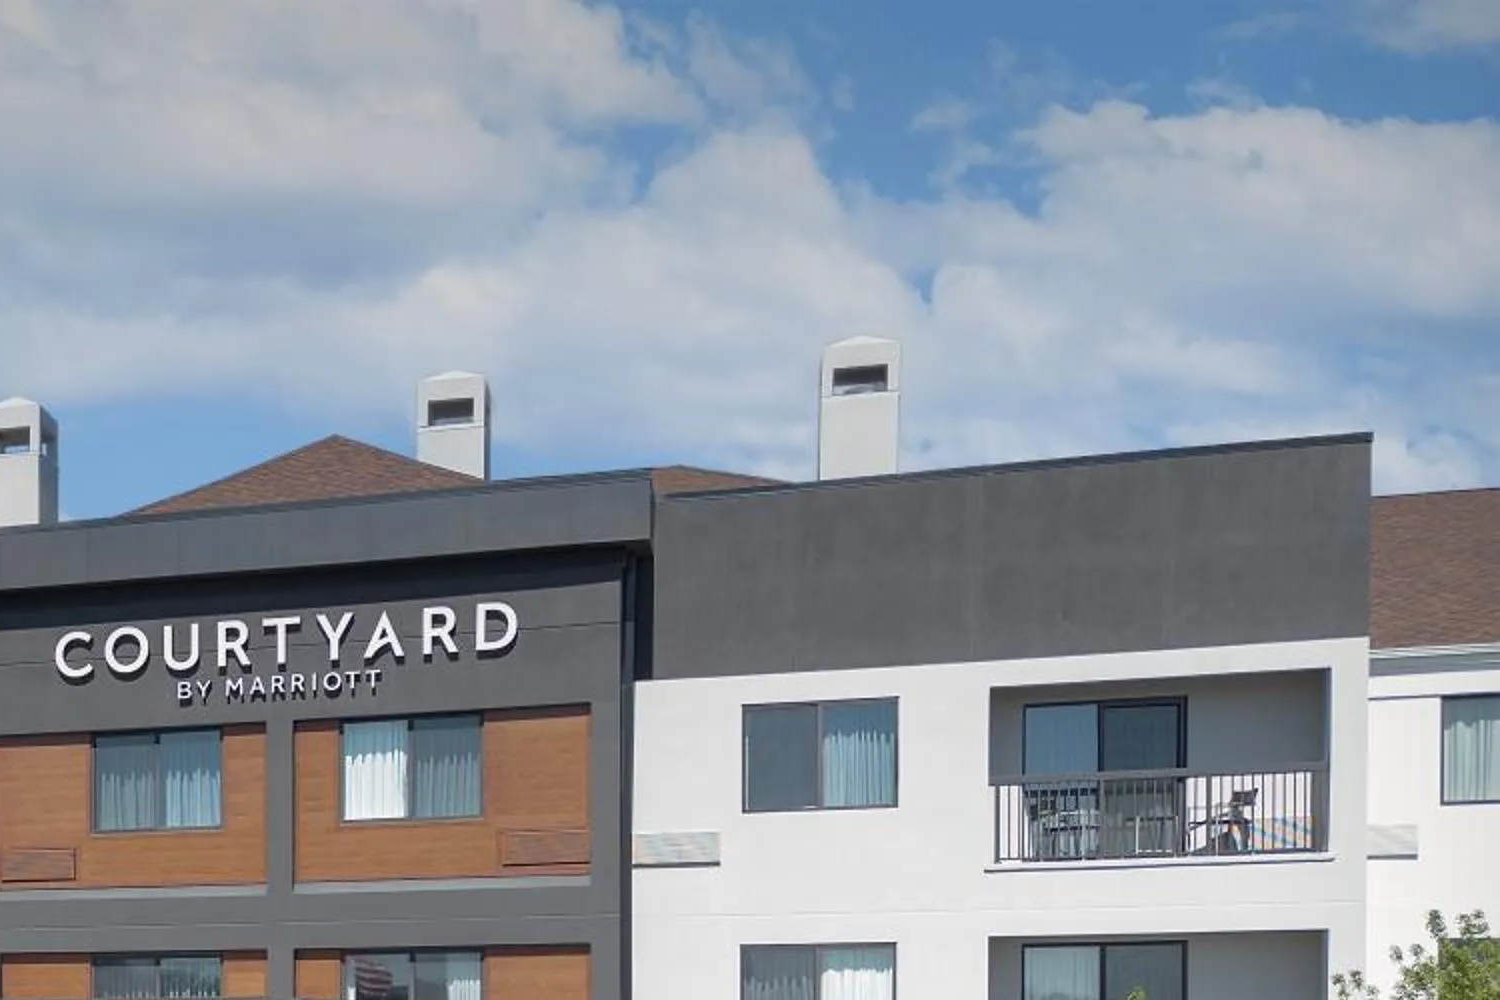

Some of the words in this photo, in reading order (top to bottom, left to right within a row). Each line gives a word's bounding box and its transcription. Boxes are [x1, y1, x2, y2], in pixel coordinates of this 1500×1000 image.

[54, 601, 519, 679] COURTYARD
[177, 680, 212, 700] BY
[225, 669, 382, 697] MARRIOTT
